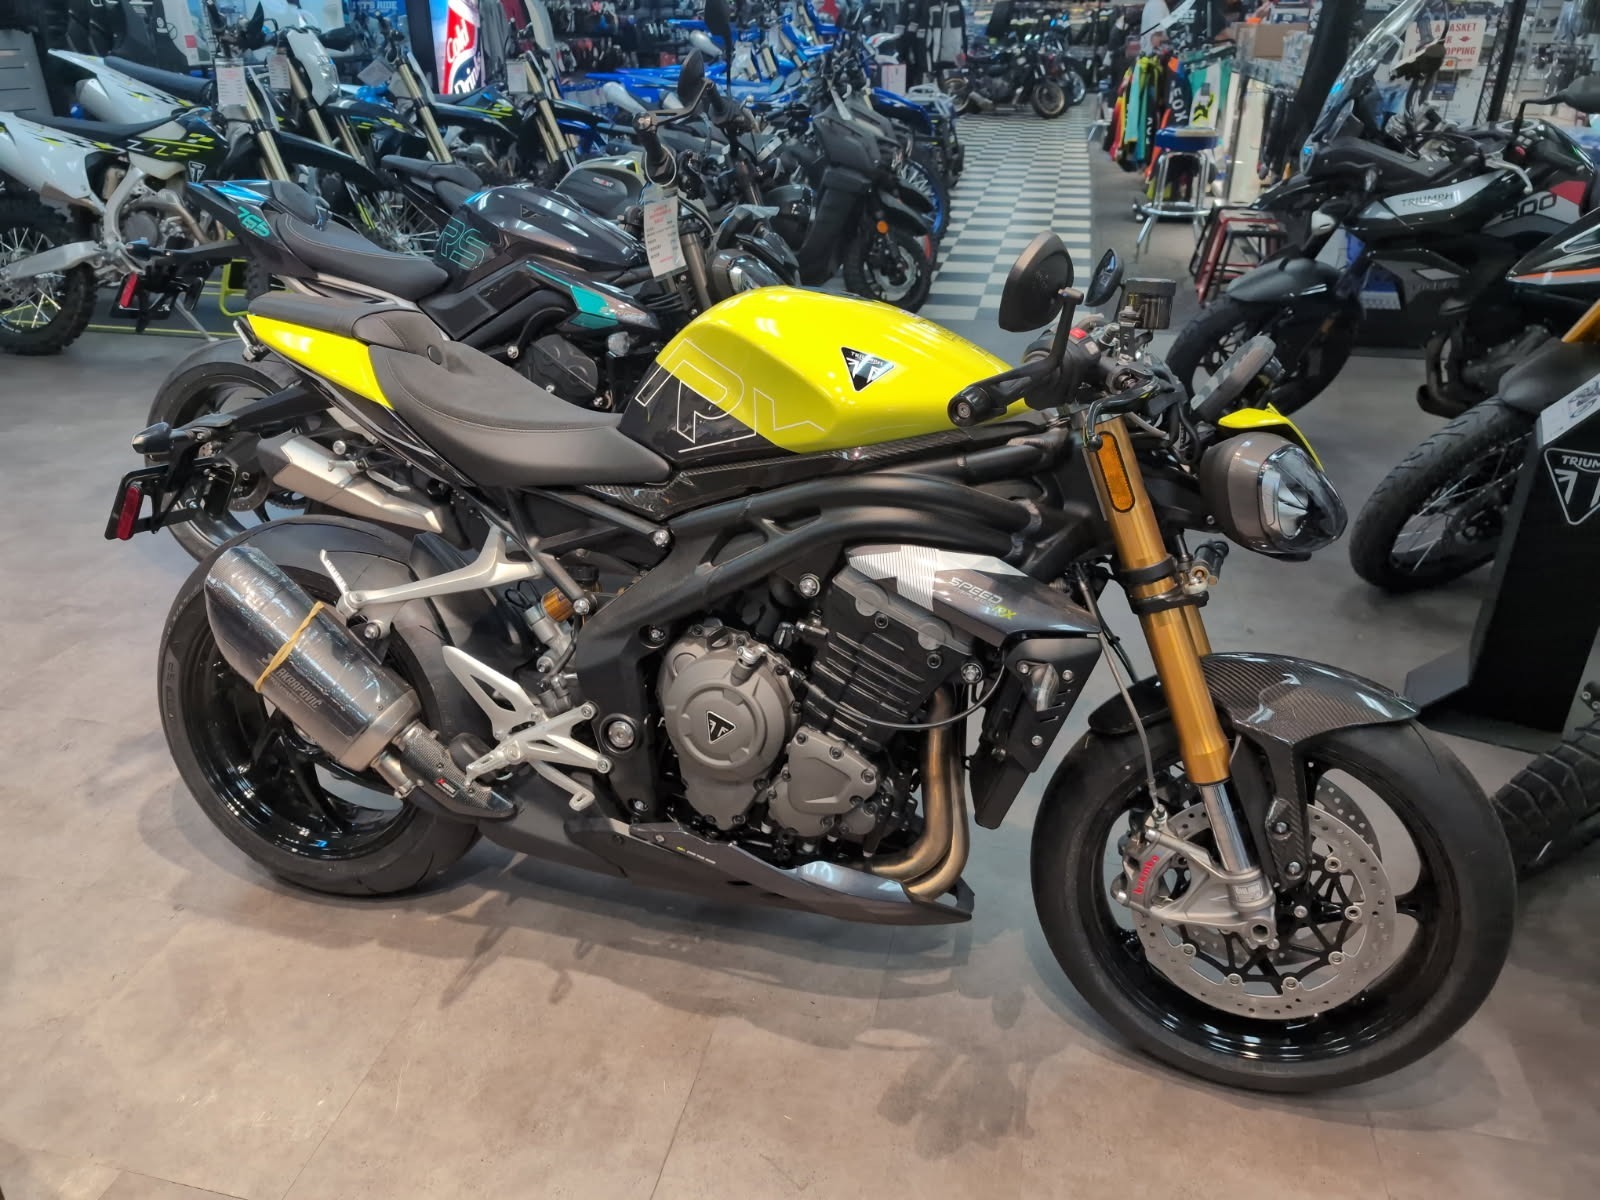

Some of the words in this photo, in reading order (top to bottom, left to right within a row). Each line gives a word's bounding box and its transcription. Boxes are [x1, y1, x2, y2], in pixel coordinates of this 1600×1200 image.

[447, 18, 470, 63] Cold
[1449, 23, 1477, 32] ASKET
[1401, 192, 1456, 207] TRIUMPH
[237, 205, 271, 237] 765
[440, 217, 489, 270] RS
[951, 577, 1002, 603] SPEED
[1132, 855, 1160, 895] brembo
